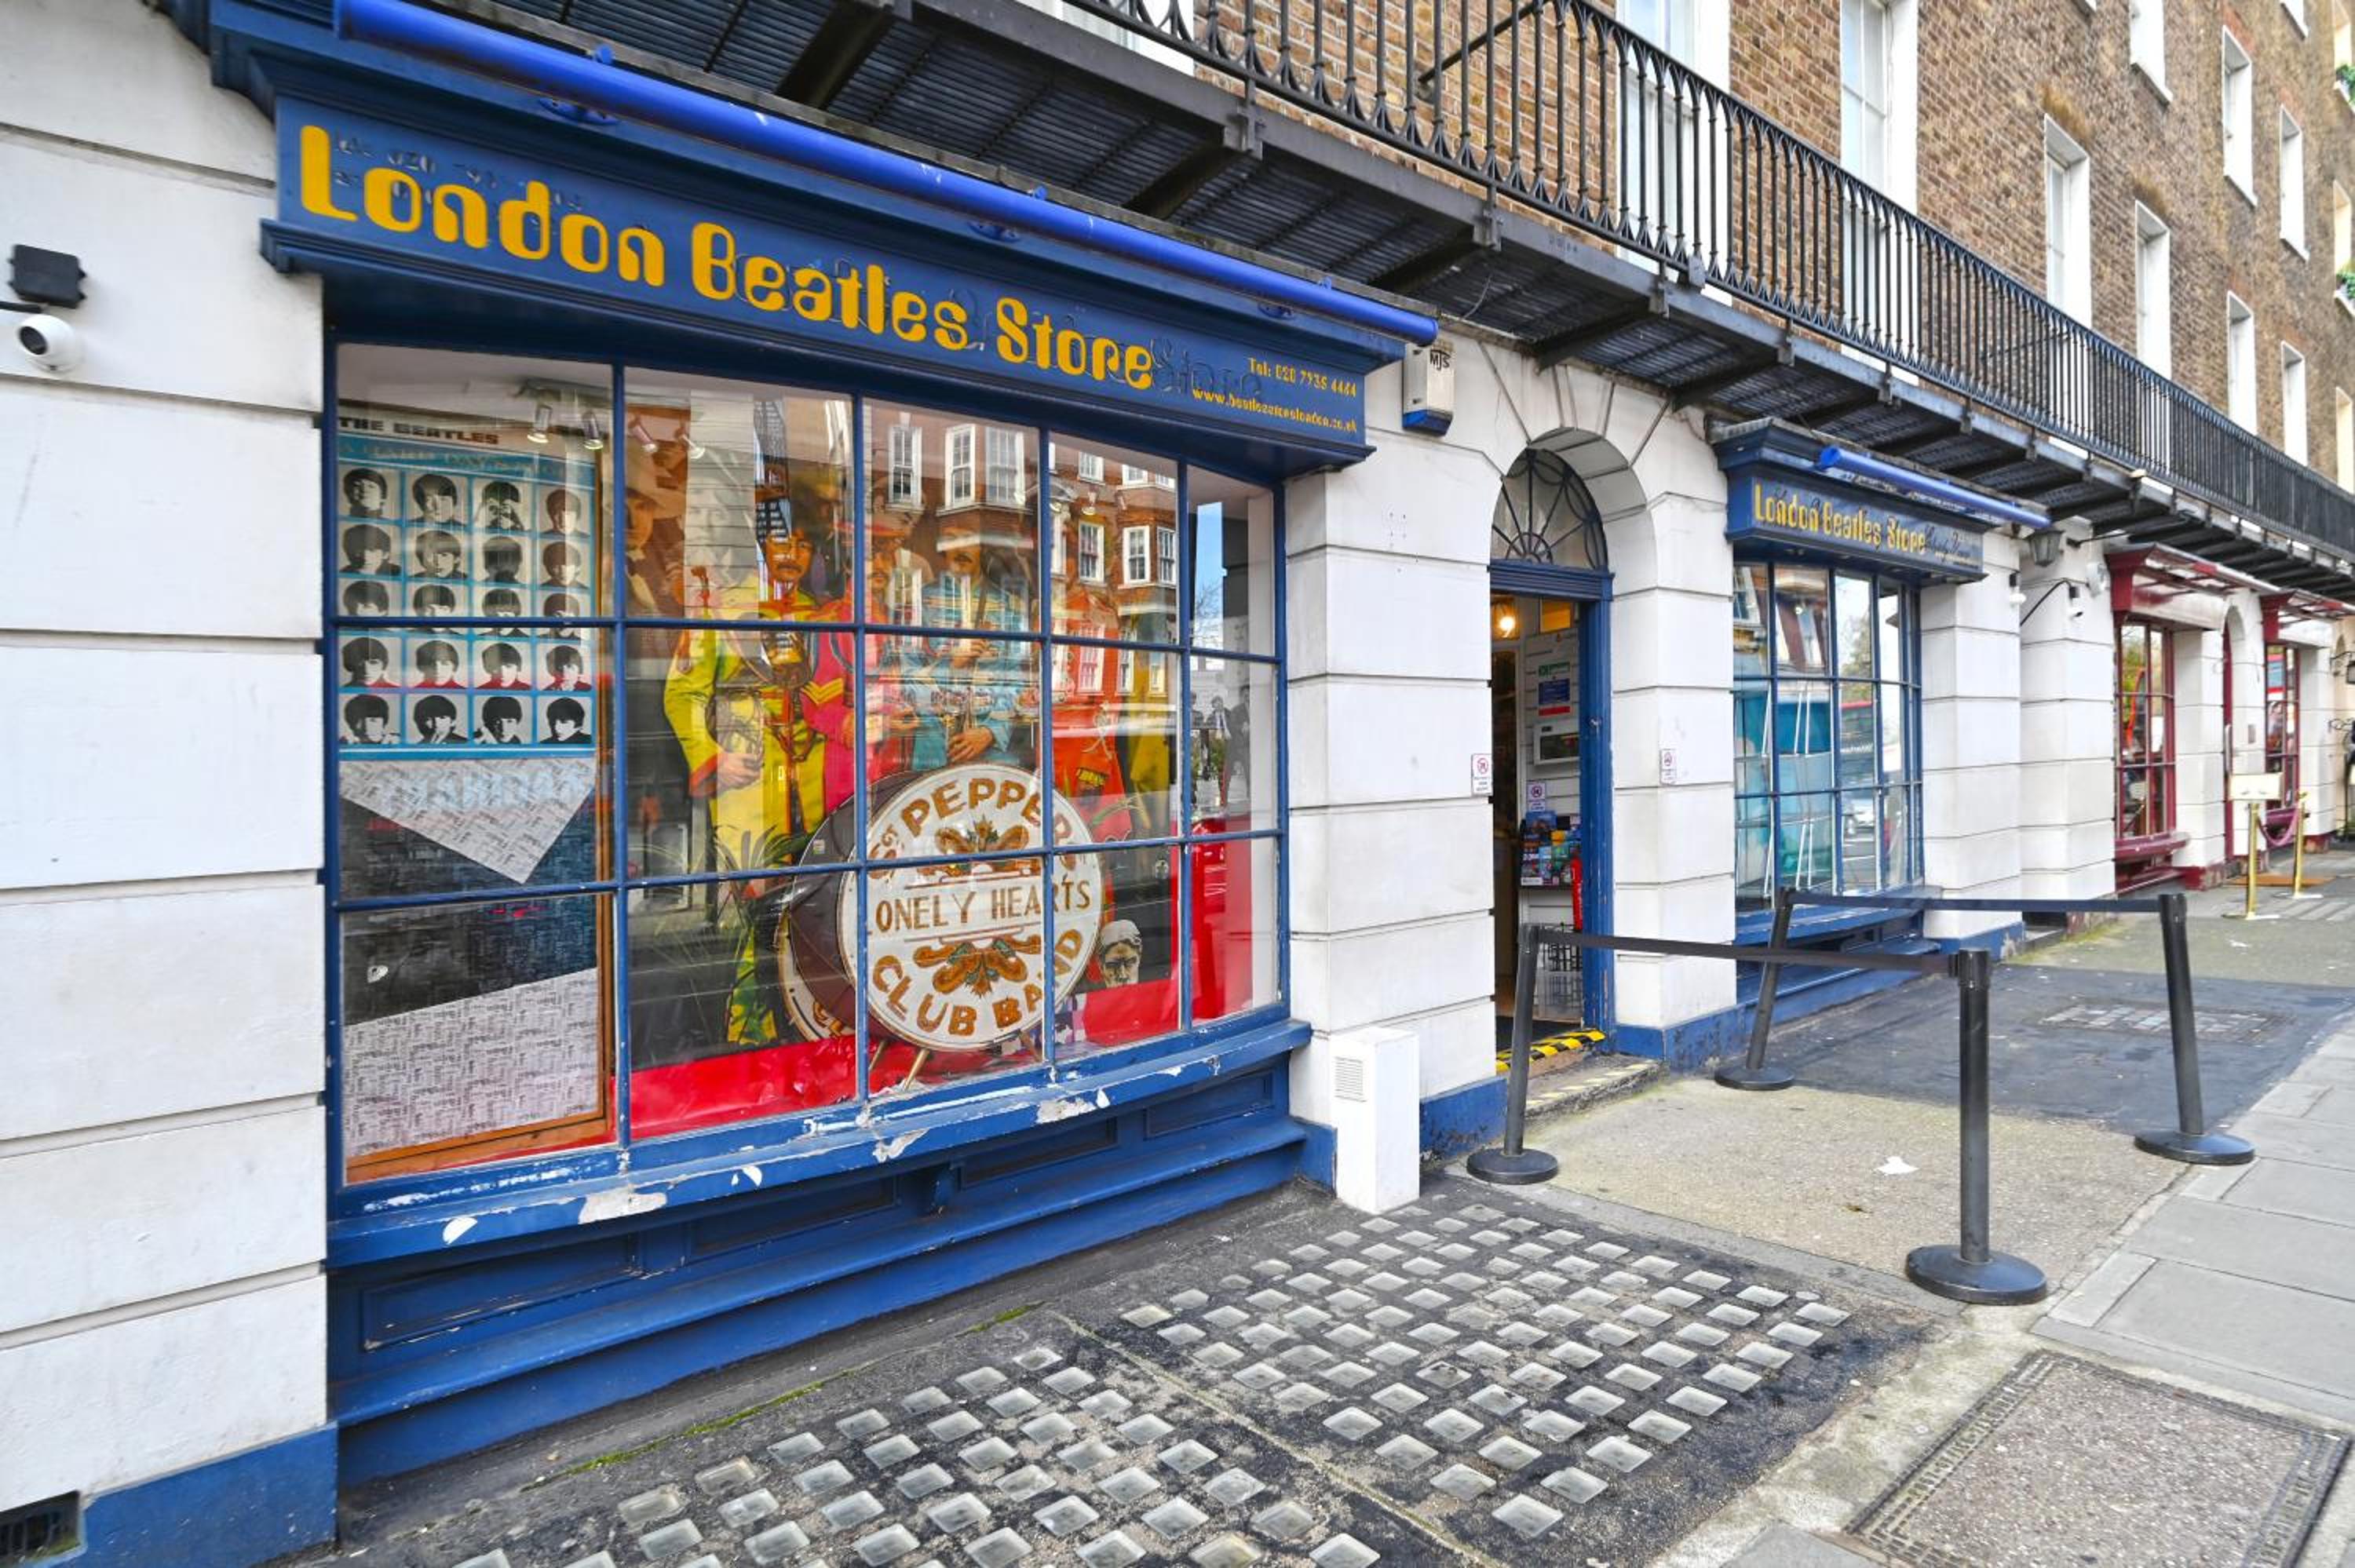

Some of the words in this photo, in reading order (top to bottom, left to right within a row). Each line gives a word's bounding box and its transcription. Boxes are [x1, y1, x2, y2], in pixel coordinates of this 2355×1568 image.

[300, 124, 666, 287] London
[692, 221, 969, 351] Beatles
[996, 297, 1153, 391] Store
[339, 416, 384, 432] THE
[394, 423, 499, 445] BEATLES
[1754, 483, 1820, 533] London
[1823, 501, 1882, 546] Beatles
[1887, 517, 1926, 556] Store
[866, 891, 977, 934] ONELY
[872, 955, 977, 1037] CLUB
